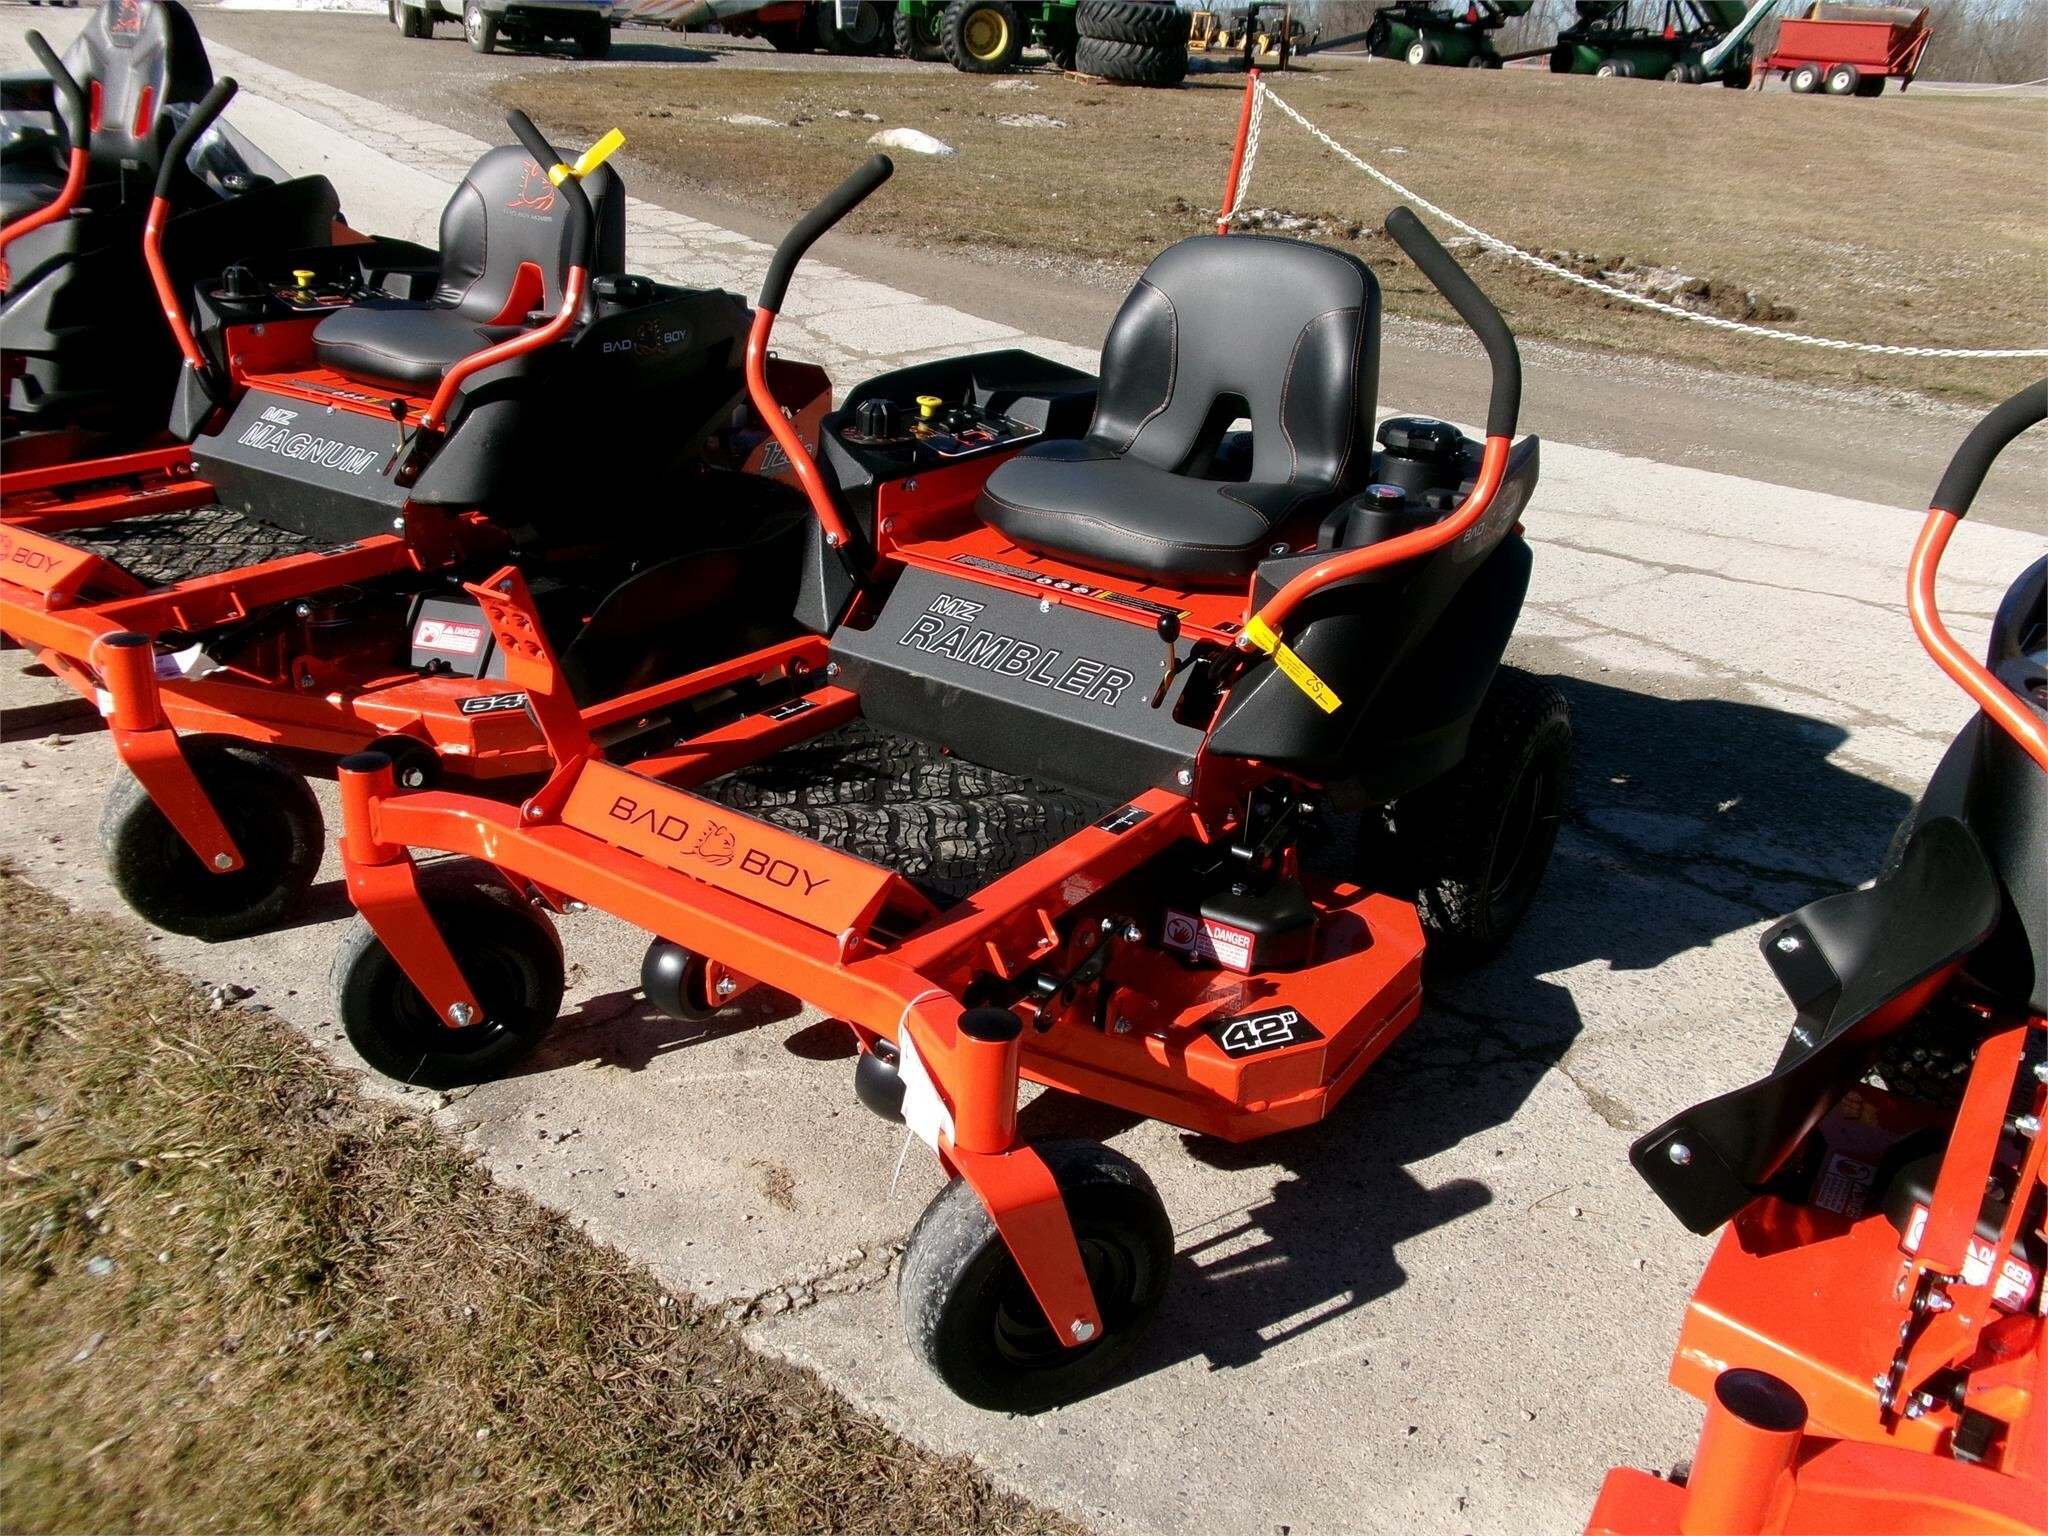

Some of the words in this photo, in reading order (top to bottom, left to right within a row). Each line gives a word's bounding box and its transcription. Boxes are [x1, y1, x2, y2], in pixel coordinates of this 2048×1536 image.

[603, 340, 632, 353] BAD
[664, 330, 686, 343] BOY
[260, 406, 298, 426] MZ
[237, 421, 379, 475] MAGNUM
[12, 547, 63, 573] BOY
[928, 594, 985, 623] MZ
[454, 626, 481, 638] DANGER
[899, 614, 1135, 708] RAMBLER
[608, 796, 689, 842] BAD
[740, 848, 831, 896] BOY
[1213, 926, 1251, 949] DANGER
